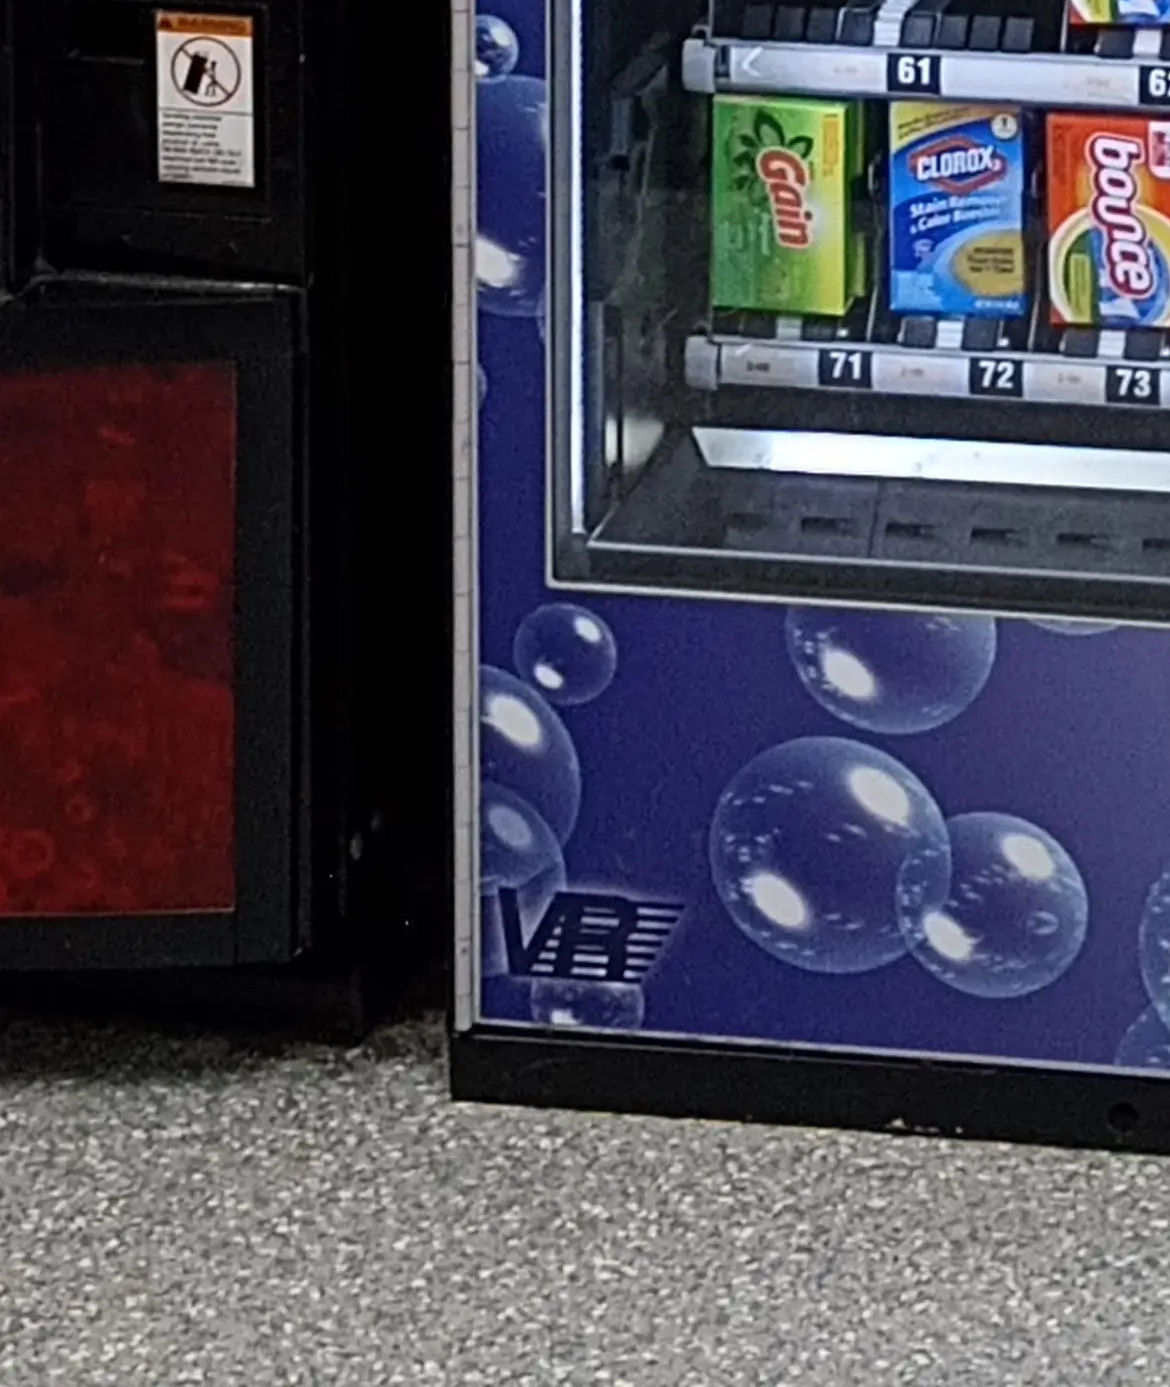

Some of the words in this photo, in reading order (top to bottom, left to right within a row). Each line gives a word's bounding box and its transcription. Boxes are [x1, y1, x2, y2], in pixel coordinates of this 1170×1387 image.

[897, 57, 931, 84] 61
[916, 145, 994, 182] CLOROX
[759, 150, 814, 246] Gain
[1092, 133, 1156, 300] bounce
[830, 353, 862, 379] 71
[979, 361, 1015, 388] 72
[1117, 370, 1150, 396] 73
